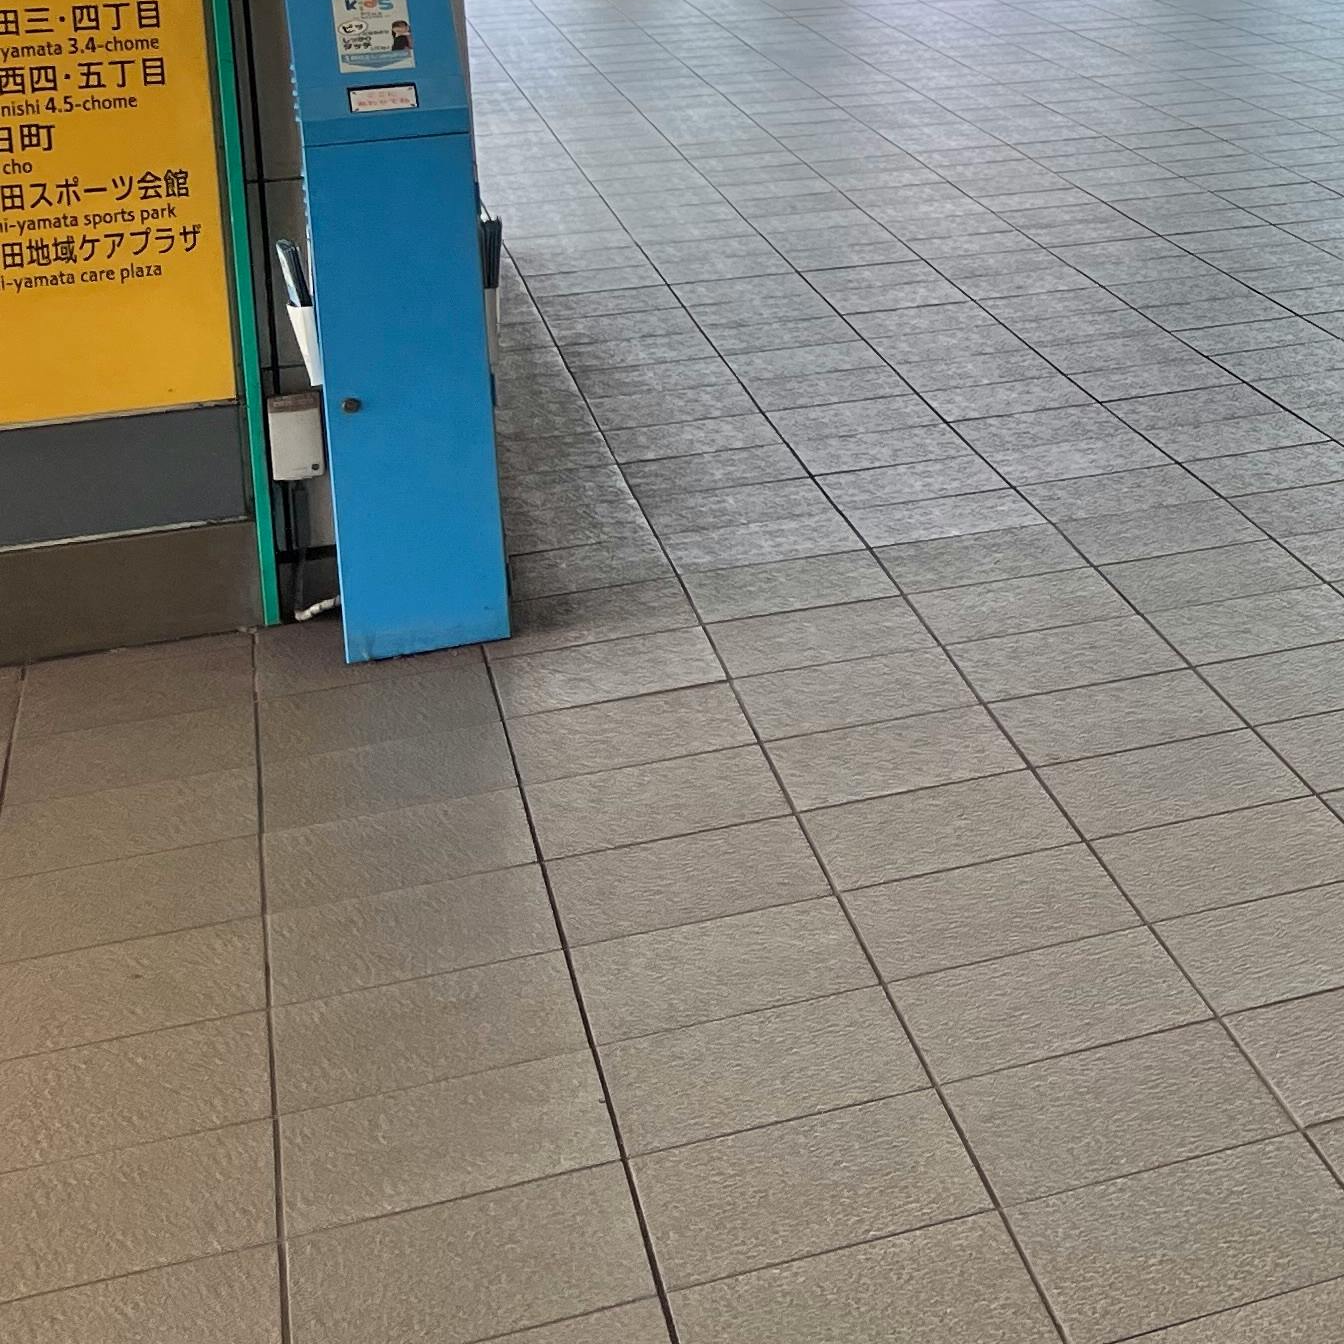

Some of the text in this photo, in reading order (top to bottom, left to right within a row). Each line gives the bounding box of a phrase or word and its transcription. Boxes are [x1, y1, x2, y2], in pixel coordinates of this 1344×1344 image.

[0, 36, 160, 62] yamata 3.4-chome
[1, 95, 138, 117] nishi 4.5-chome
[3, 159, 32, 175] cho
[0, 169, 189, 212] 田スポーツ会館
[84, 208, 135, 229] sports
[140, 203, 177, 225] park
[2, 223, 201, 270] 田地域ケアプラザ
[81, 267, 115, 283] care
[120, 263, 162, 284] plaza
